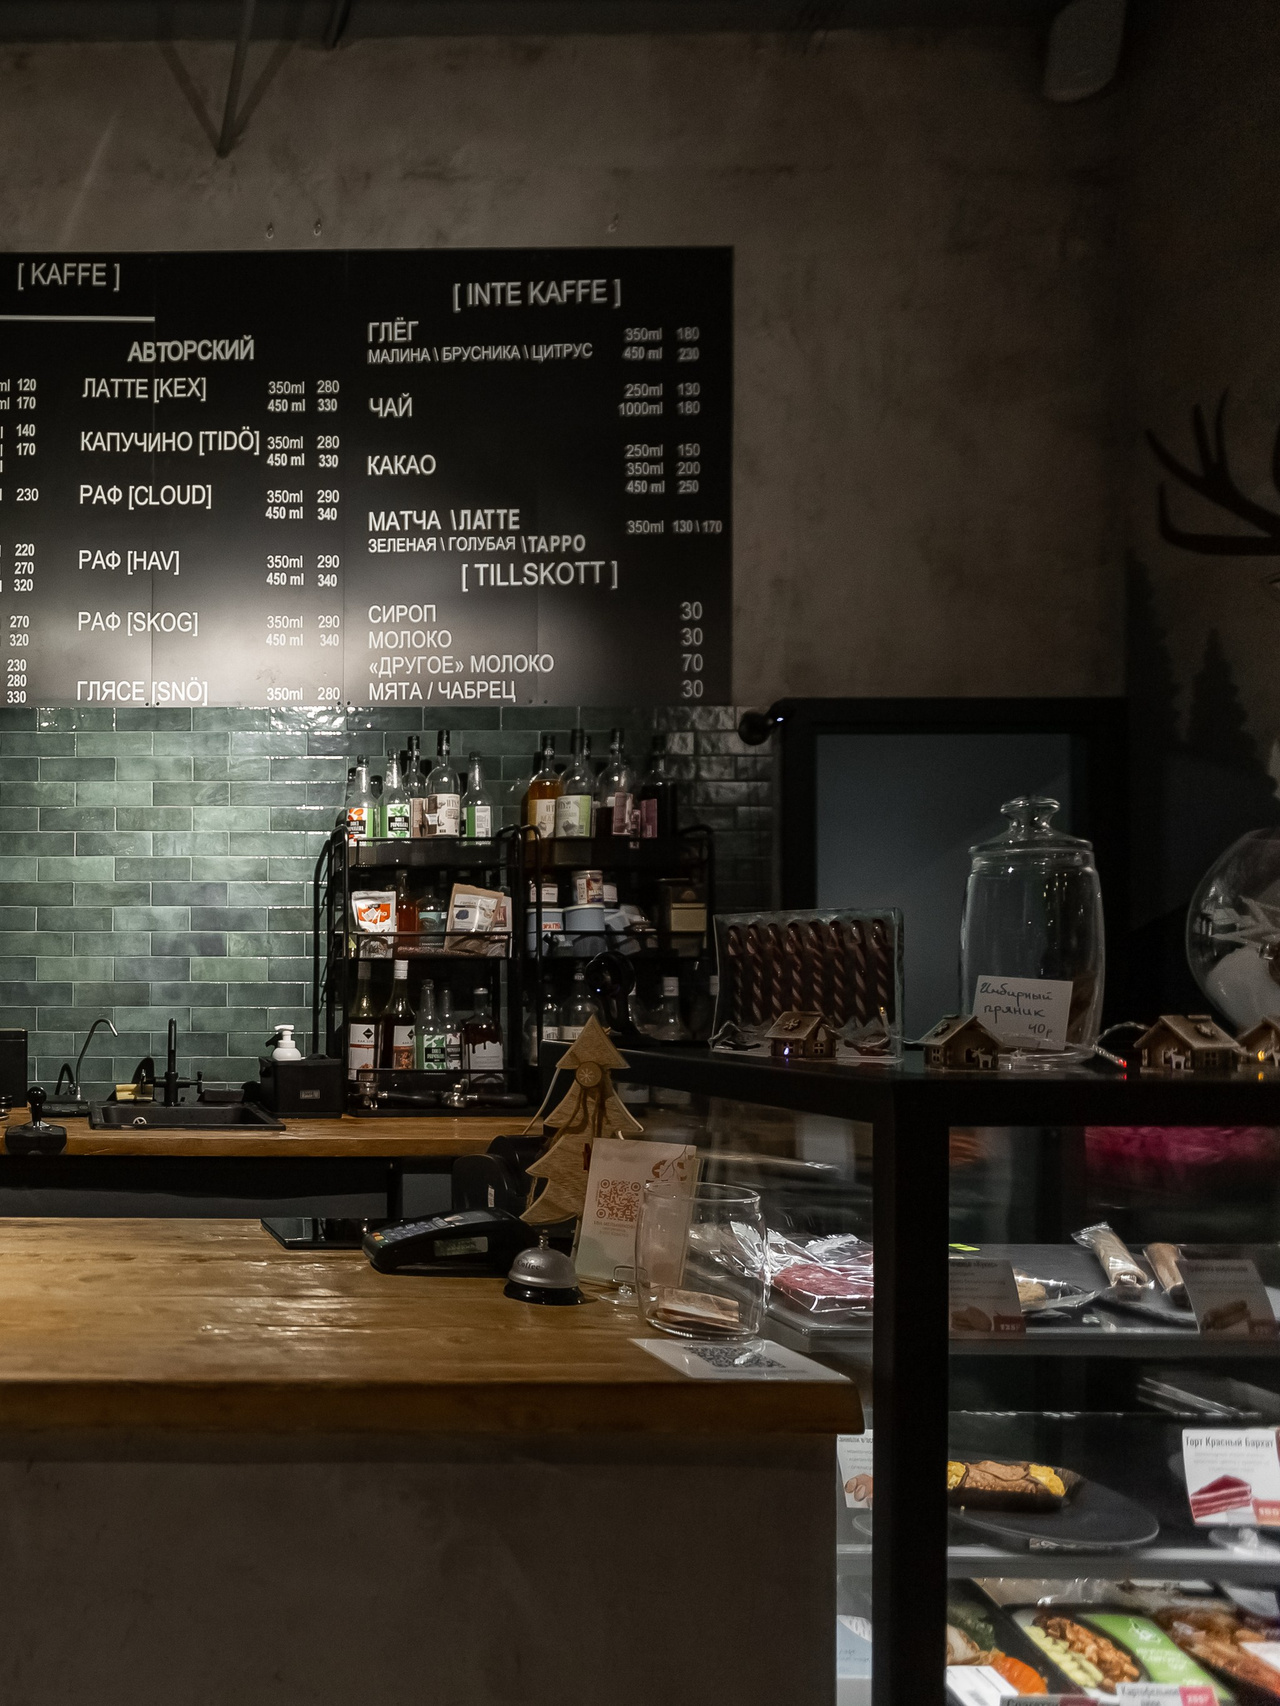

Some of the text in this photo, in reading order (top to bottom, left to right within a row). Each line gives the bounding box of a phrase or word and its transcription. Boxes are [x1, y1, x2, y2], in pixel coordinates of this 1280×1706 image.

[369, 320, 418, 342] ГЛЁГ
[625, 327, 699, 341] 350ml 180
[128, 335, 254, 362] АВТОРСКИЙ
[369, 348, 430, 363] МАЛИНА
[443, 345, 520, 361] БРУСНИКА
[533, 343, 592, 361] ЦИТРУС
[18, 378, 36, 391] 120
[83, 377, 206, 403] ЛАТТЕ [KEX]
[269, 380, 339, 394] 350ml 280
[626, 383, 700, 396] 250ml 130
[17, 397, 36, 409] 170
[268, 399, 337, 411] 450 ml 330
[370, 393, 412, 417] ЧАЙ
[619, 401, 700, 415] 1000ml 180
[17, 424, 35, 436] 140
[81, 426, 259, 456] КАПУЧИНО [TIDÖ]
[268, 436, 339, 449] 350ml 280
[17, 443, 35, 455] 170
[627, 444, 700, 457] 250ml 150
[267, 453, 338, 467] 450 ml 330
[368, 455, 436, 475] КАКАО
[627, 462, 700, 475] 350ml 200
[627, 480, 698, 493] 450 ml 250
[17, 488, 38, 501] 230
[80, 485, 211, 510] РАФ [CLOUD]
[267, 490, 339, 503] 350ml 290
[266, 507, 337, 520] 450 ml 340
[628, 520, 664, 533] 350ml
[673, 520, 693, 532] 130
[703, 520, 722, 533] 170
[15, 544, 34, 556] 220
[15, 562, 34, 574] 270
[79, 550, 179, 575] РАФ [HAV]
[267, 555, 339, 568] 350ml 290
[14, 579, 33, 591] 320
[267, 573, 337, 586] 450 ml 340
[369, 605, 435, 623] СИРОП
[682, 602, 702, 619] 30
[10, 616, 29, 627] 270
[79, 612, 197, 636] РАФ [SKOG]
[267, 615, 339, 628] 350ml 290
[10, 634, 28, 646] 320
[266, 634, 339, 646] 450 ml 340
[369, 630, 451, 648] МОЛОКО
[682, 628, 703, 645] 30
[7, 659, 26, 671] 230
[370, 654, 554, 678] «ДРУГОЕ» МОЛОКО
[683, 654, 703, 671] 70
[7, 675, 26, 686] 280
[77, 677, 208, 706] ГЛЯСЕ [SNÖ]
[267, 687, 340, 700] 350ml 280
[370, 683, 422, 700] МЯТА
[439, 681, 515, 702] ЧАБРЕЦ
[683, 680, 703, 697] 30
[7, 691, 26, 703] 330
[980, 982, 1053, 1007] Имбирный
[984, 1004, 1046, 1024] пряник
[517, 1259, 541, 1271] Coffee
[1186, 1436, 1274, 1449] Торт Красный Бархат
